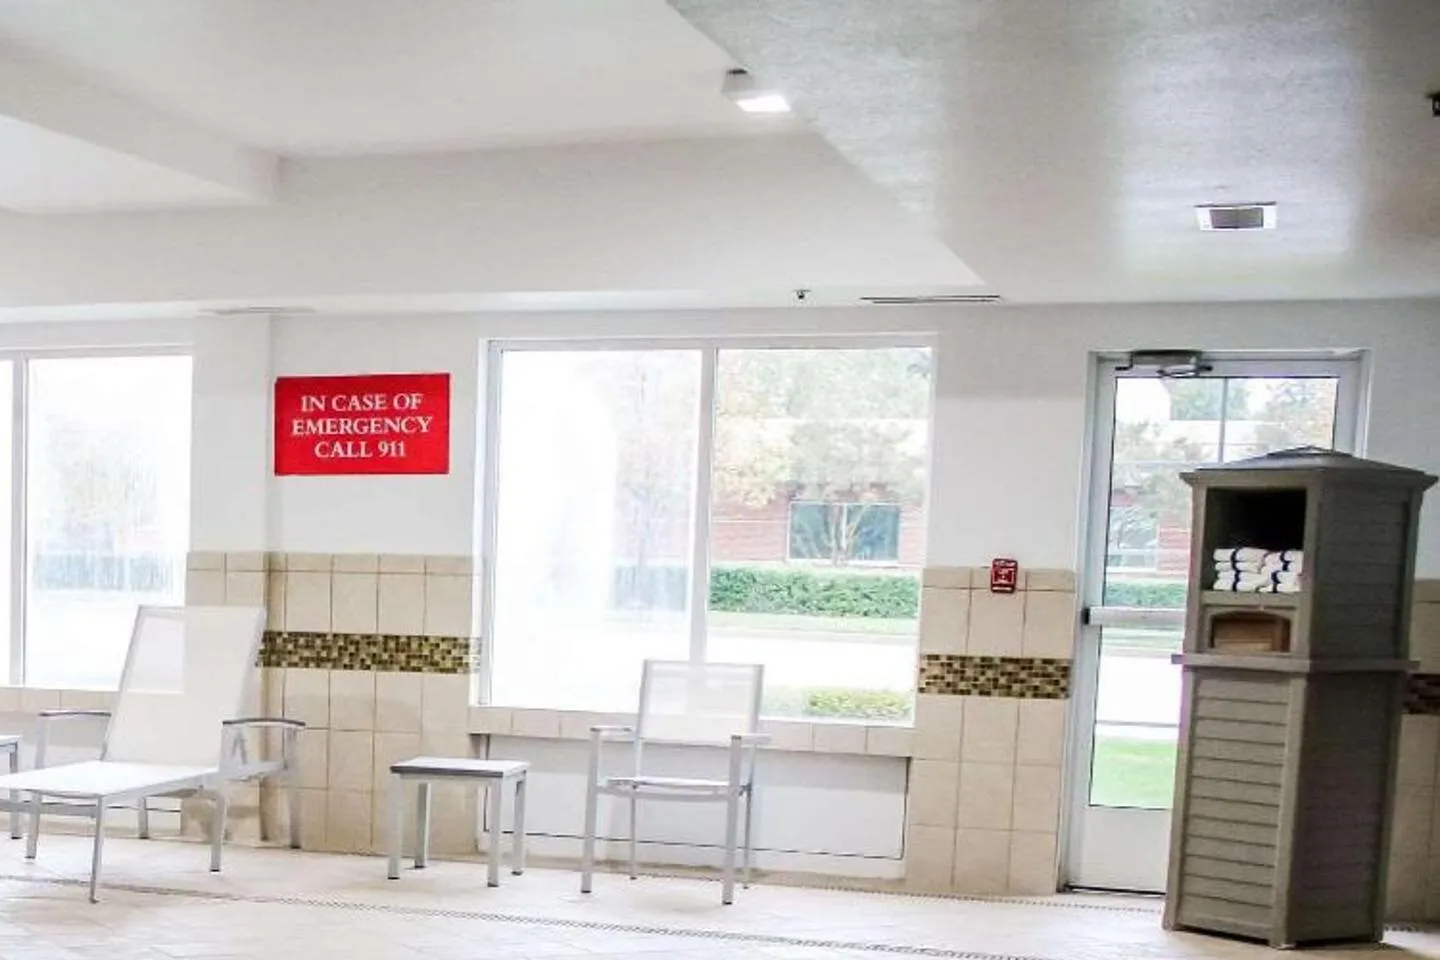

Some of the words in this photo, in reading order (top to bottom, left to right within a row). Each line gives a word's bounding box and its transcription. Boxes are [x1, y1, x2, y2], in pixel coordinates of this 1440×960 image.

[301, 395, 325, 412] IN
[332, 394, 387, 411] CASE
[393, 392, 423, 410] OF
[292, 416, 432, 436] EMERGENCY
[314, 441, 373, 458] CALL
[378, 440, 406, 457] 911
